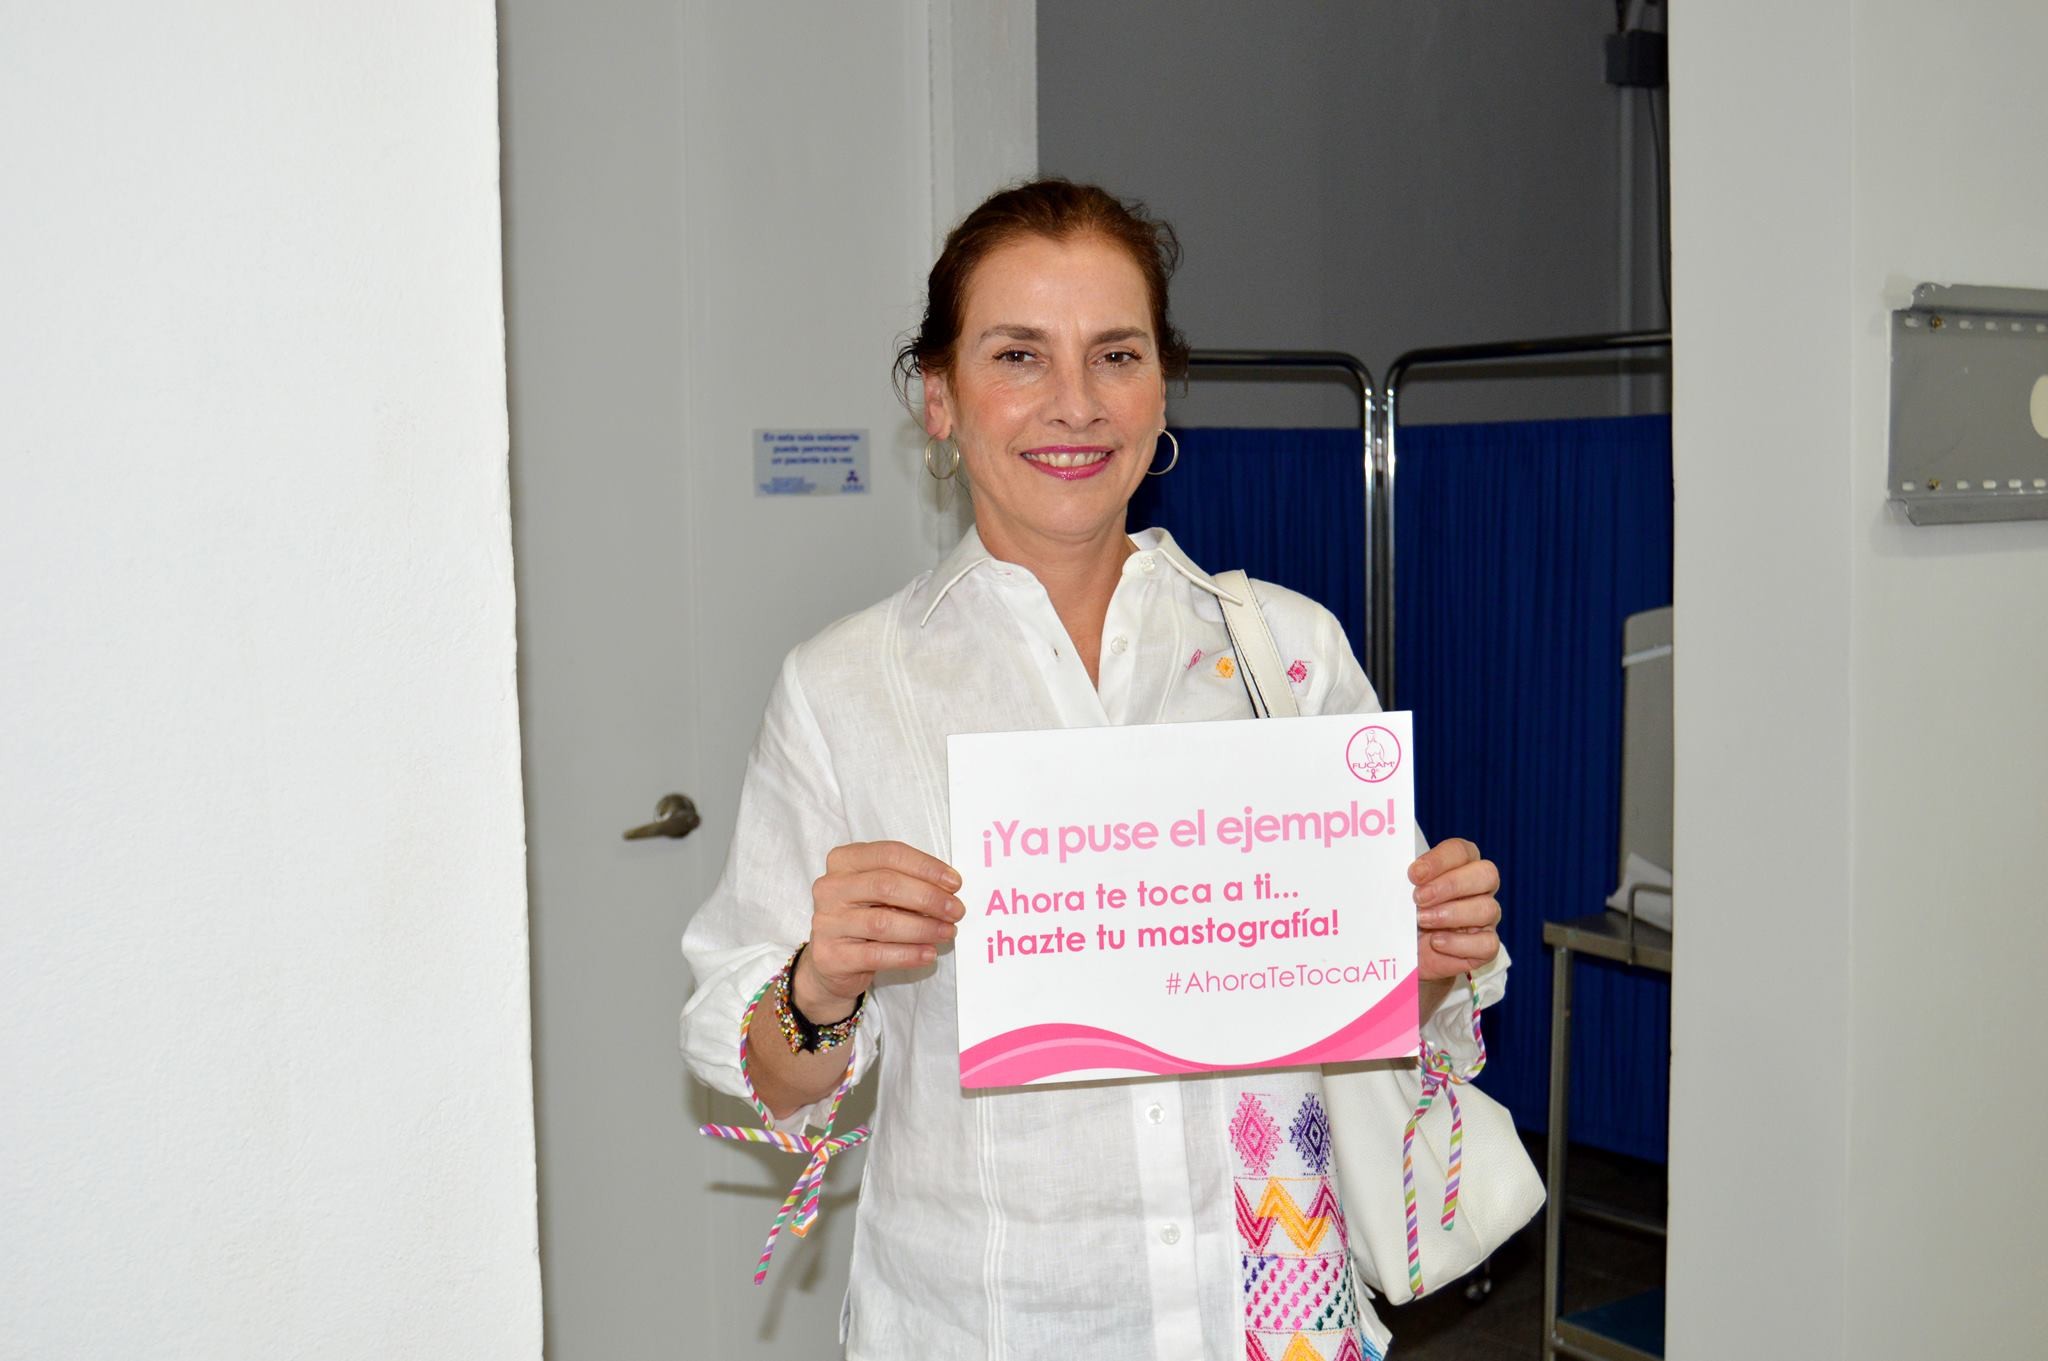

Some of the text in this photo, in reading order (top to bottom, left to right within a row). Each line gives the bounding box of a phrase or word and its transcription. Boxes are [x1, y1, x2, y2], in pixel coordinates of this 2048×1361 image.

[982, 798, 1396, 868] ¡Ya puse el ejemplo!
[984, 873, 1300, 917] Ahora te toca a ti...
[986, 908, 1340, 965] ¡hazte tu mastografía!
[1165, 958, 1398, 996] #AhoraTeTocaATi
